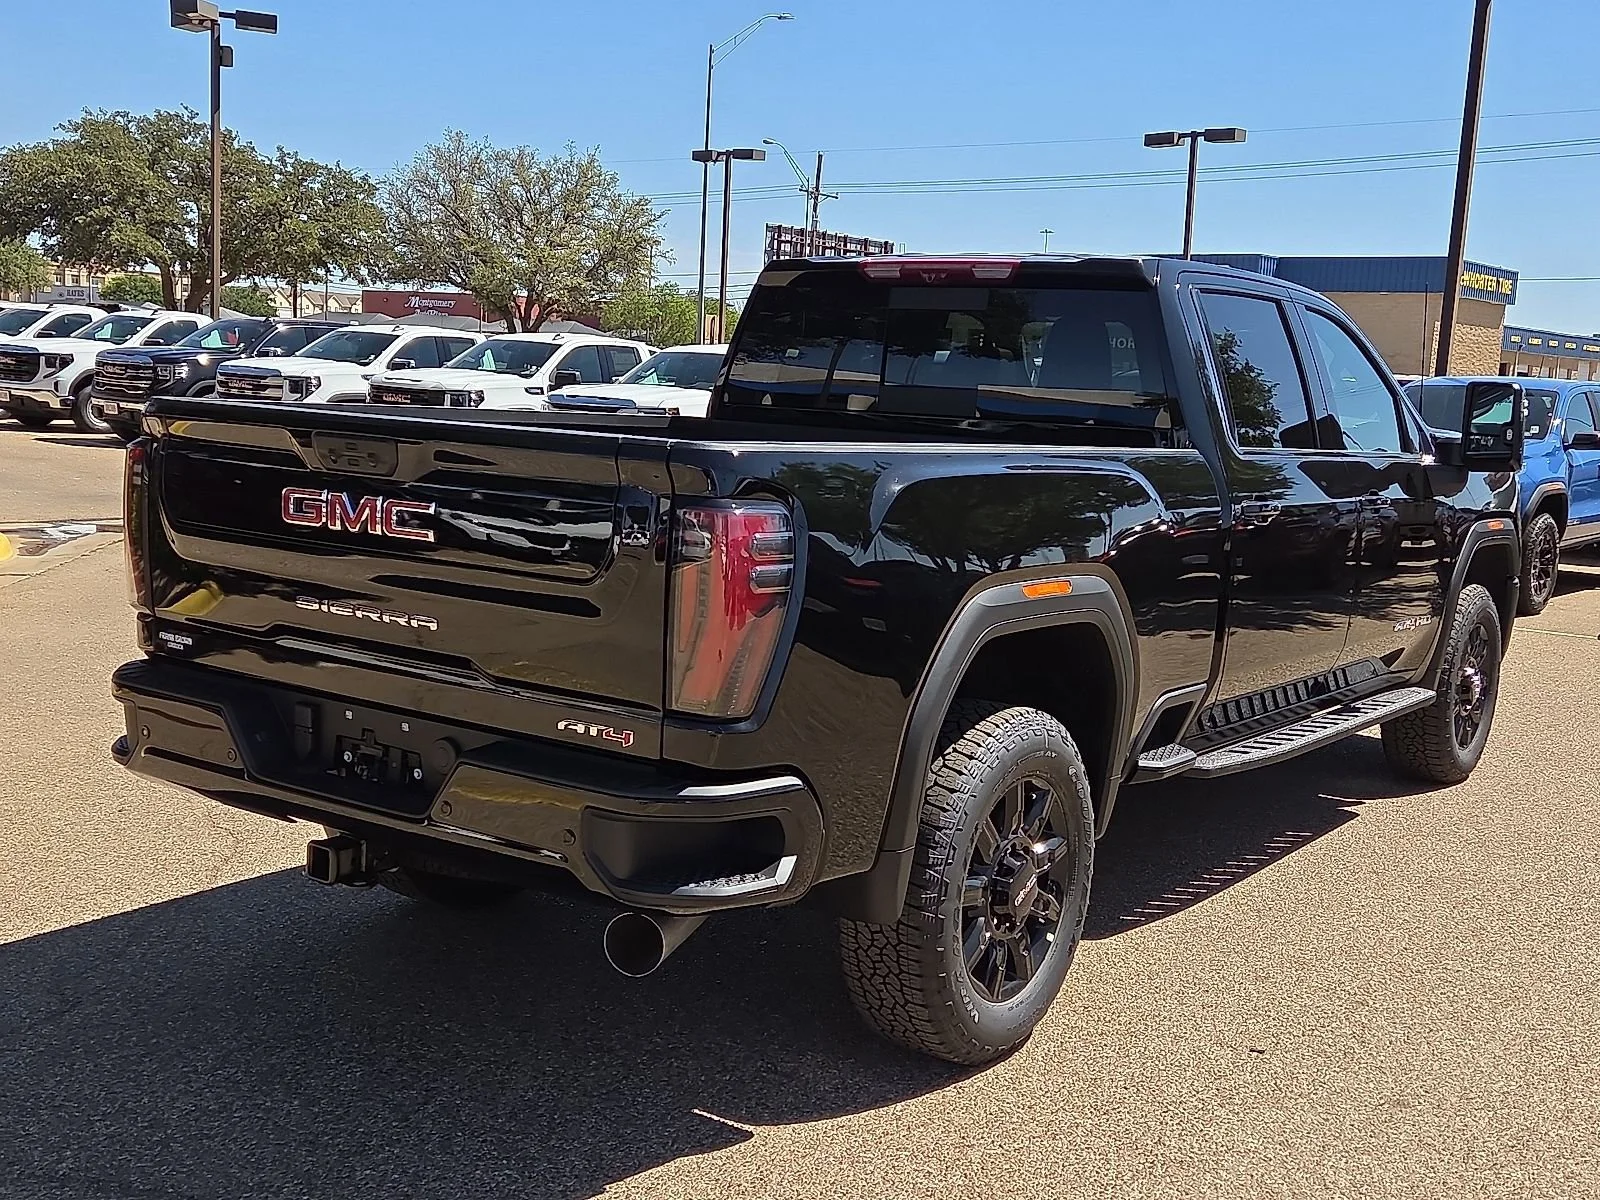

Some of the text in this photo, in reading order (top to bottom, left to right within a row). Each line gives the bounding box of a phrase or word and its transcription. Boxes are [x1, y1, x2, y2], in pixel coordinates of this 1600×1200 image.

[1460, 270, 1513, 295] cWHORTER TIRE
[404, 295, 457, 309] Montgomery
[281, 486, 436, 543] GMC
[295, 595, 439, 631] SIERRA
[557, 719, 634, 748] AT4
